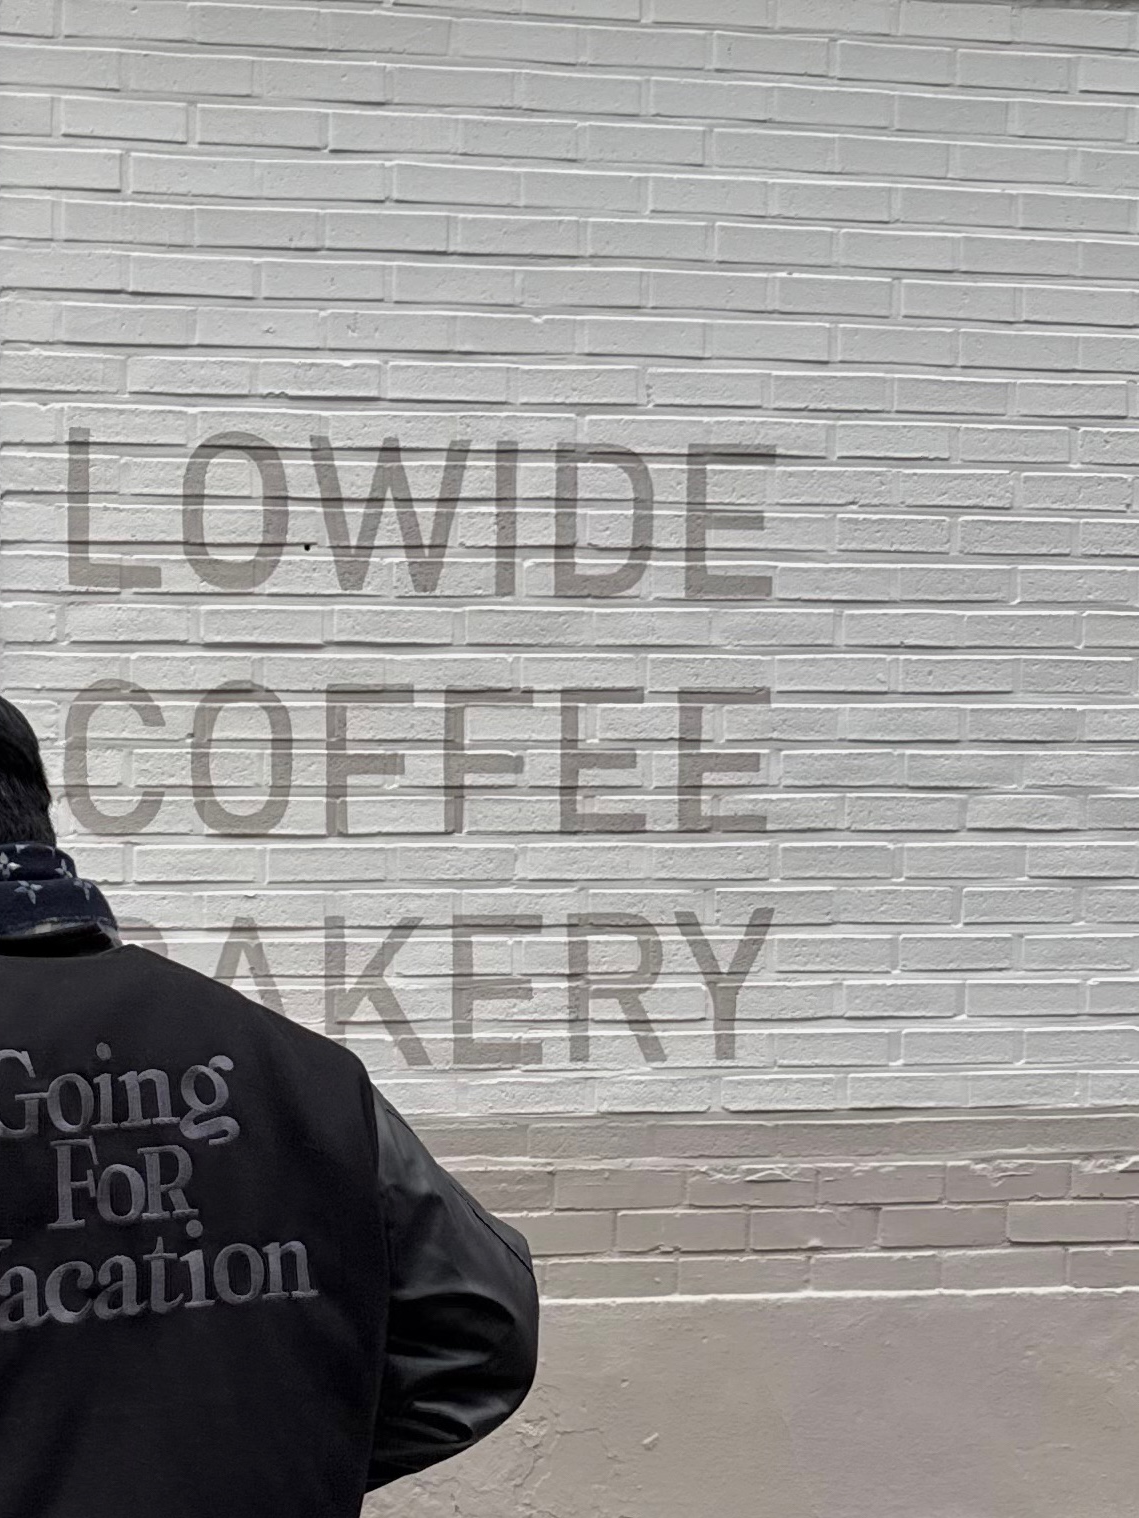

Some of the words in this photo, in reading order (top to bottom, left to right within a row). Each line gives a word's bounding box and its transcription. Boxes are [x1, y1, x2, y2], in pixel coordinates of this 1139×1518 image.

[66, 426, 777, 599] LOWIDE
[63, 678, 772, 836] COFFEE
[47, 1136, 199, 1230] FoR
